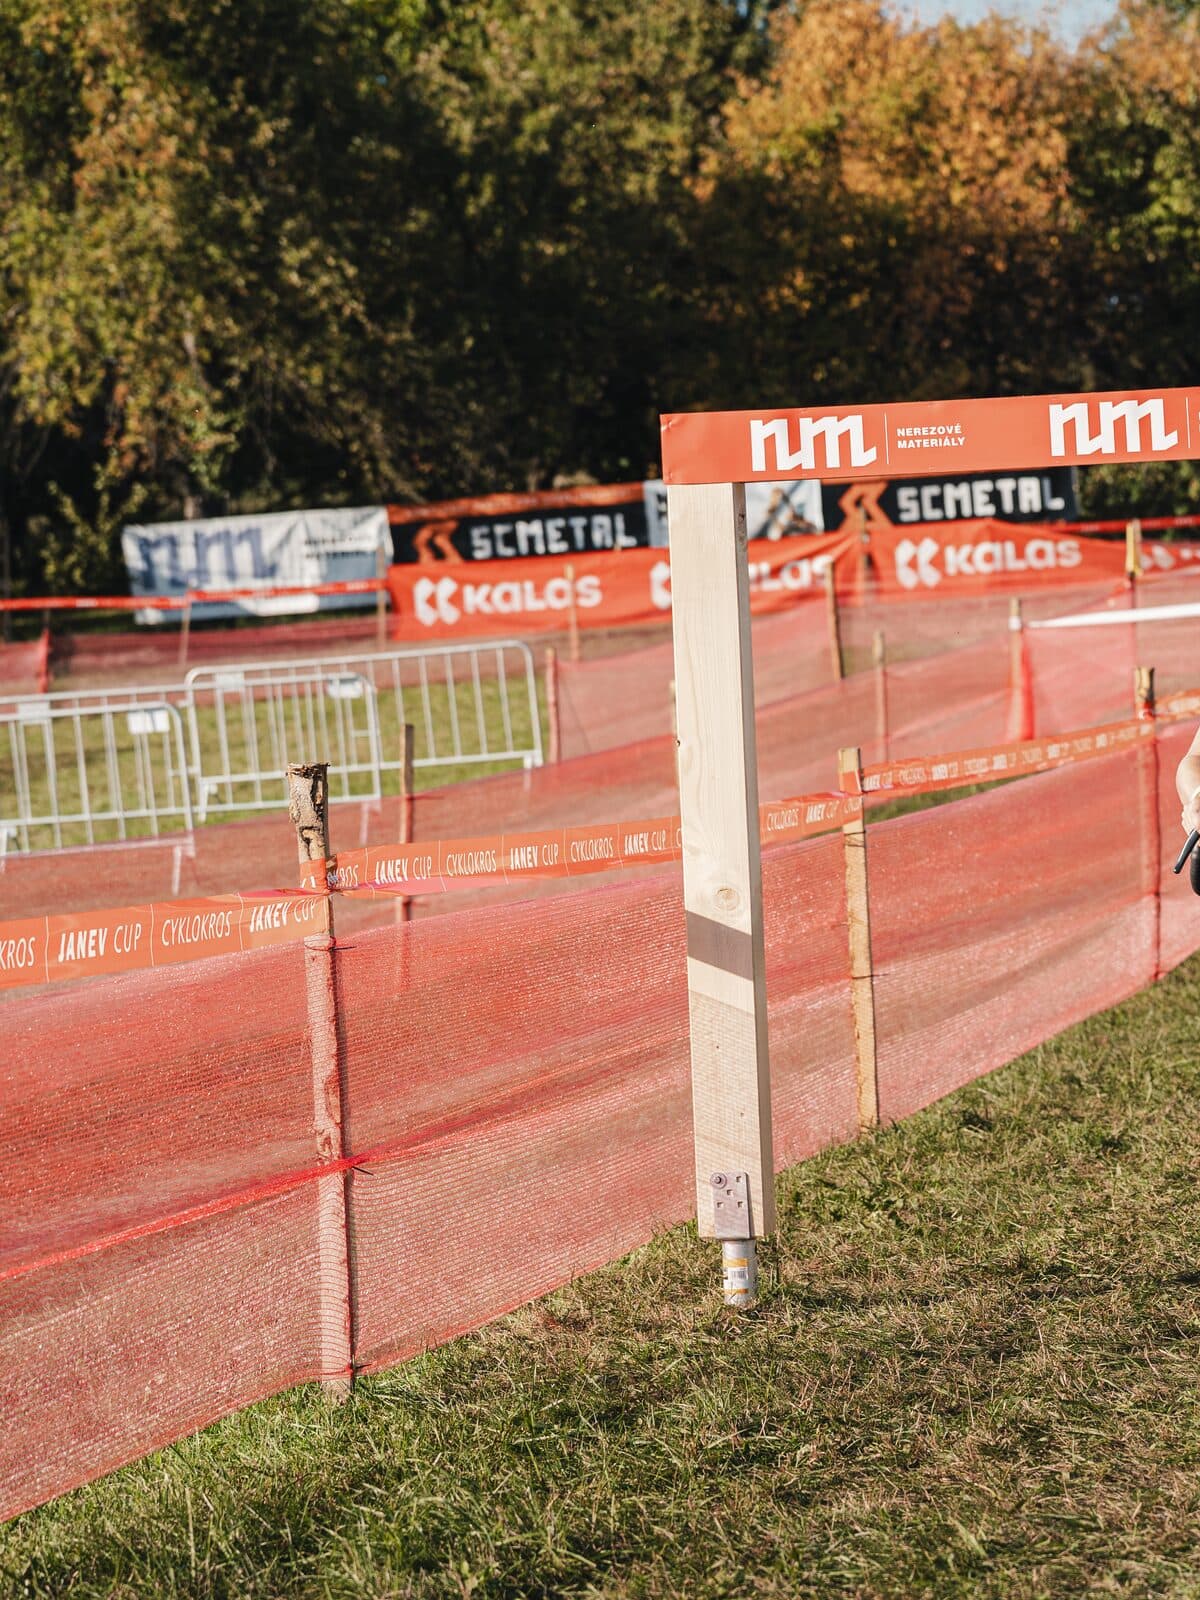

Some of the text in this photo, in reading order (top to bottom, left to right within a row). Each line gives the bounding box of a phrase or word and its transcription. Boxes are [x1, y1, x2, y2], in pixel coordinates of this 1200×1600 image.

[897, 422, 962, 436] NEREZOVÉ
[897, 435, 966, 449] MATERIÁLY
[896, 476, 1066, 523] SCMETAL
[468, 511, 638, 560] SCMETAL
[510, 843, 559, 870] JANEV CUP
[570, 837, 614, 863] CYKLOKROS
[625, 832, 649, 856] JANEV
[651, 829, 666, 851] CUP
[375, 855, 432, 884] JANEV CUP
[446, 849, 497, 877] CYKLOKROS
[161, 910, 233, 946] CYKLOKROS
[249, 899, 317, 933] JANEV CUP
[58, 923, 142, 963] JANEV CUP
